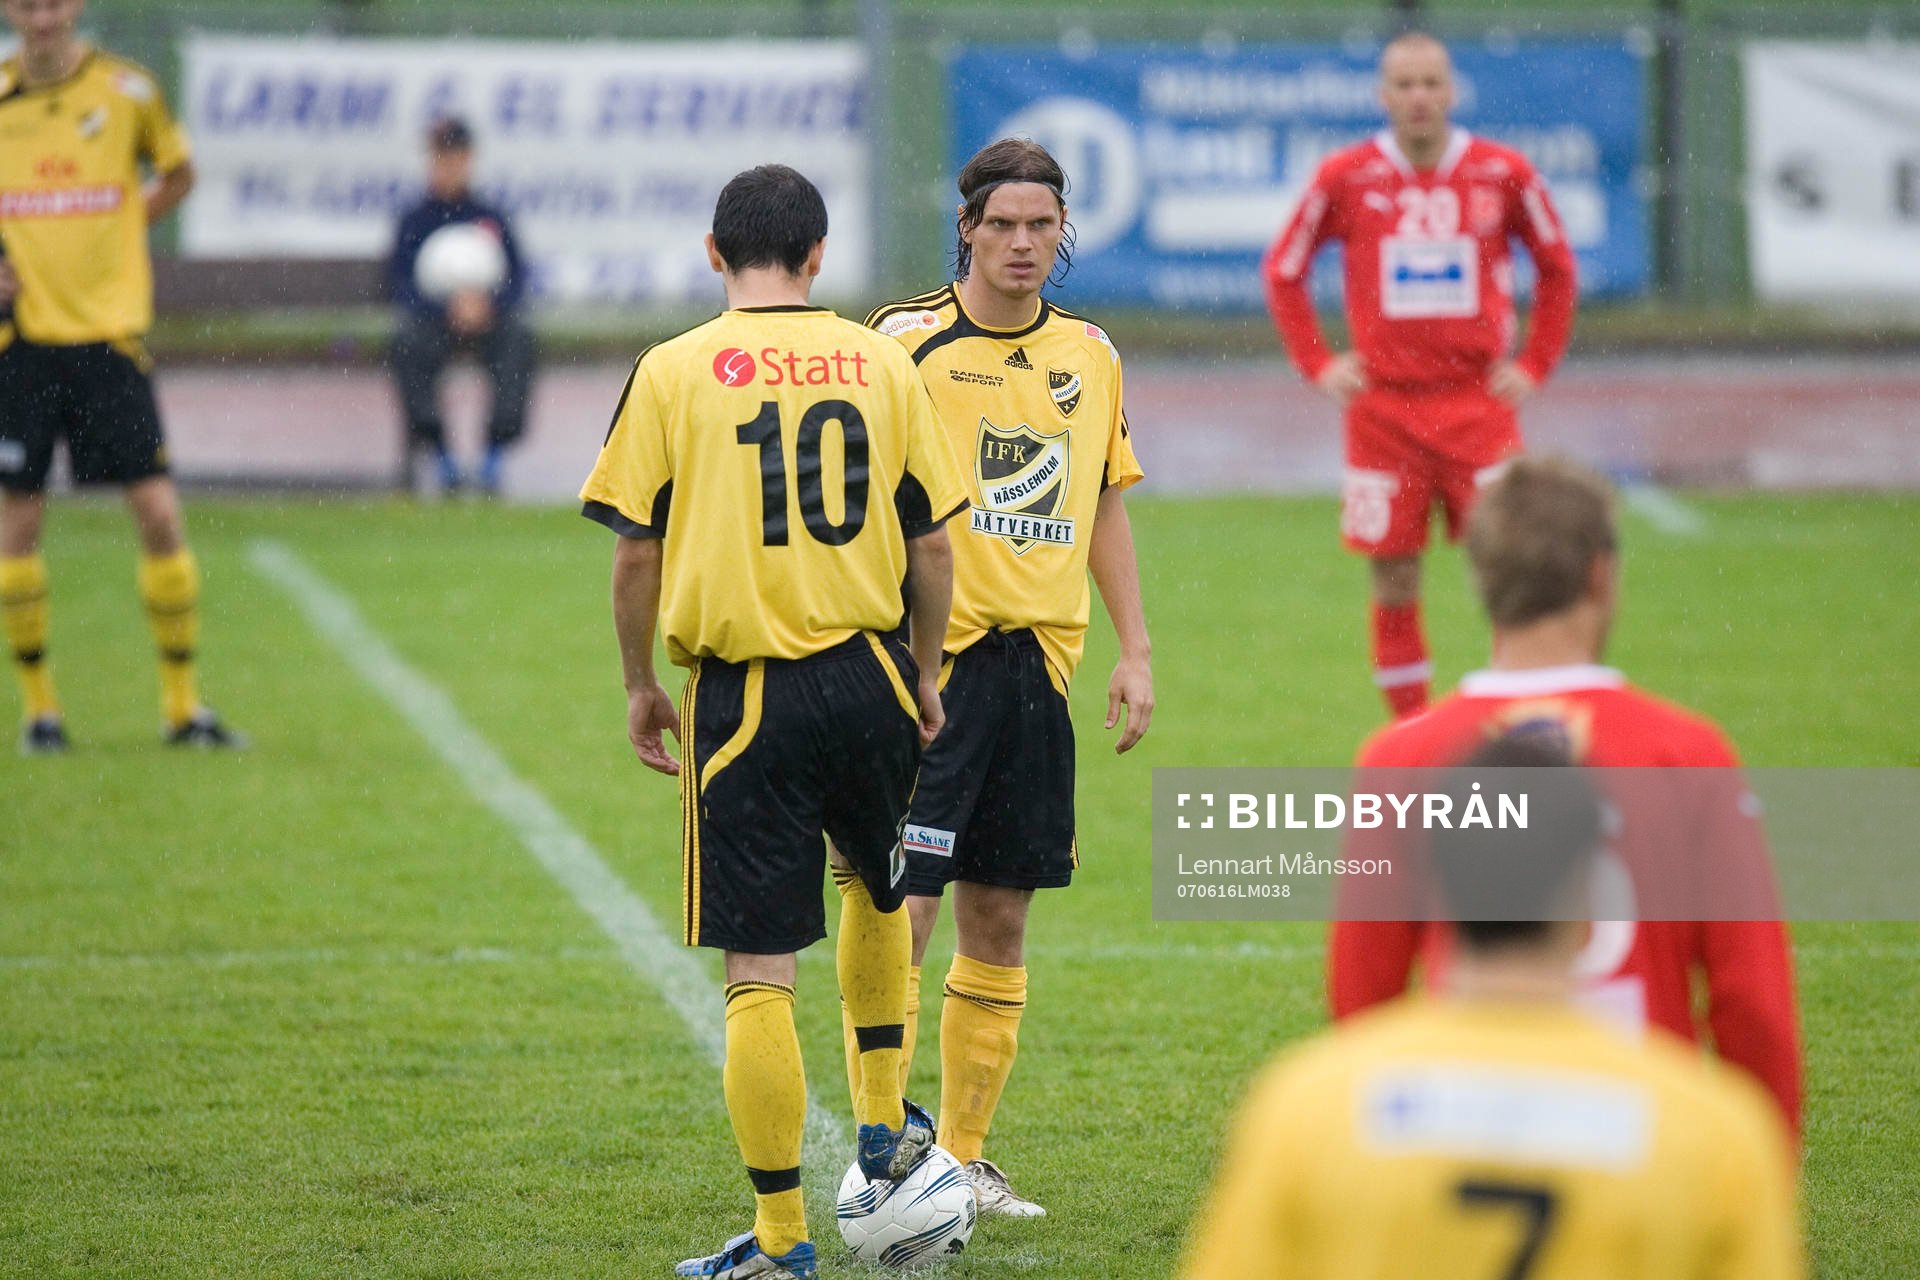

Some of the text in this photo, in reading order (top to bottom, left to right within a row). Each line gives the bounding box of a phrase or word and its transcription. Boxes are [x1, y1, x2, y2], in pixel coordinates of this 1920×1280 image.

[760, 347, 869, 388] Statt
[949, 369, 1004, 382] BAREKO
[1004, 359, 1034, 371] adidas
[964, 378, 1003, 387] SPORT
[1050, 373, 1068, 384] IFK
[985, 440, 1027, 464] IFK
[736, 399, 870, 547] 10
[993, 455, 1060, 505] HÄSSLEHOLM
[974, 512, 1072, 541] NÄTVERKET
[1454, 1176, 1560, 1280] 7
